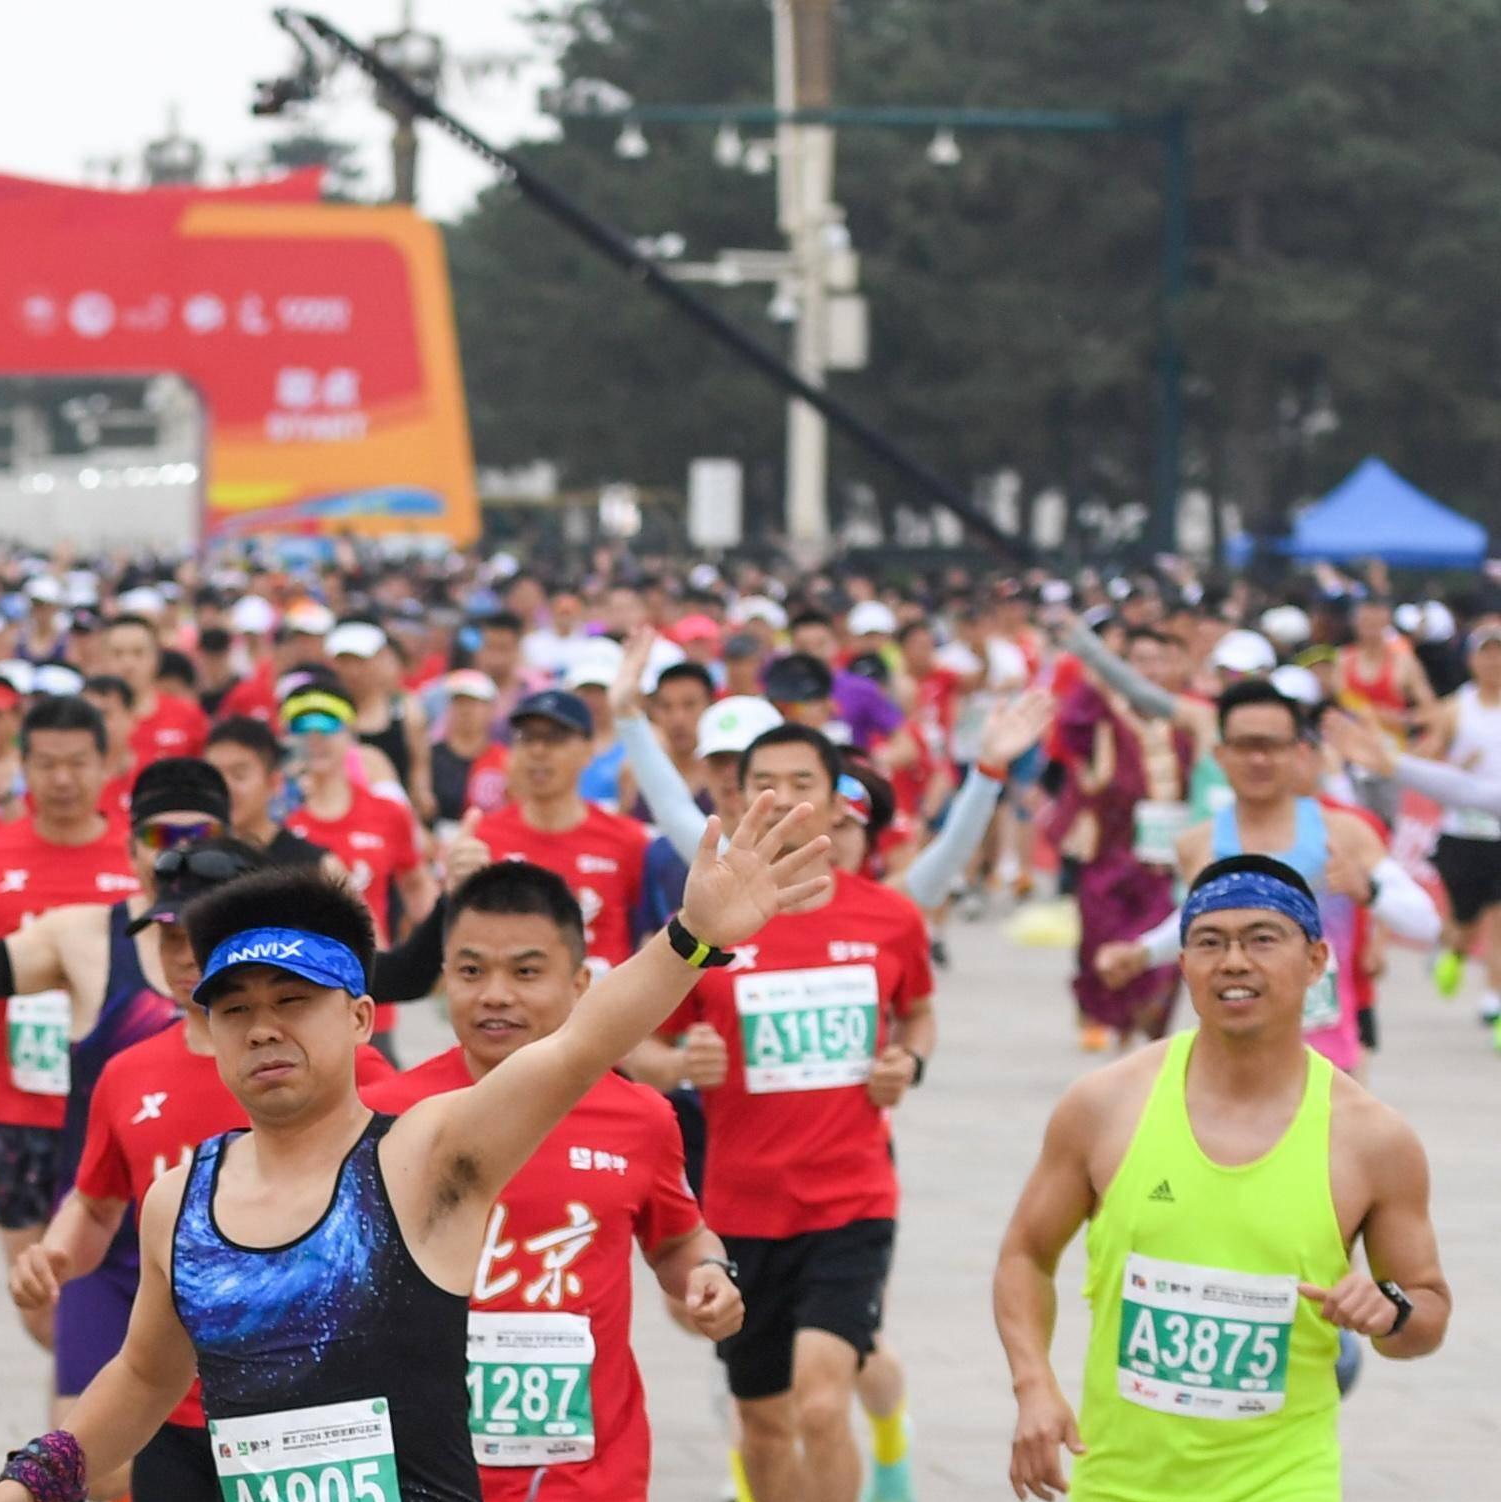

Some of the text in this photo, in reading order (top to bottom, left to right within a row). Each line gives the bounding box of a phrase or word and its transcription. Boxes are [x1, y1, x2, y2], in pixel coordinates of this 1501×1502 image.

[753, 1007, 869, 1056] A1150
[1128, 1308, 1280, 1378] A3875
[466, 1365, 581, 1422] 1287
